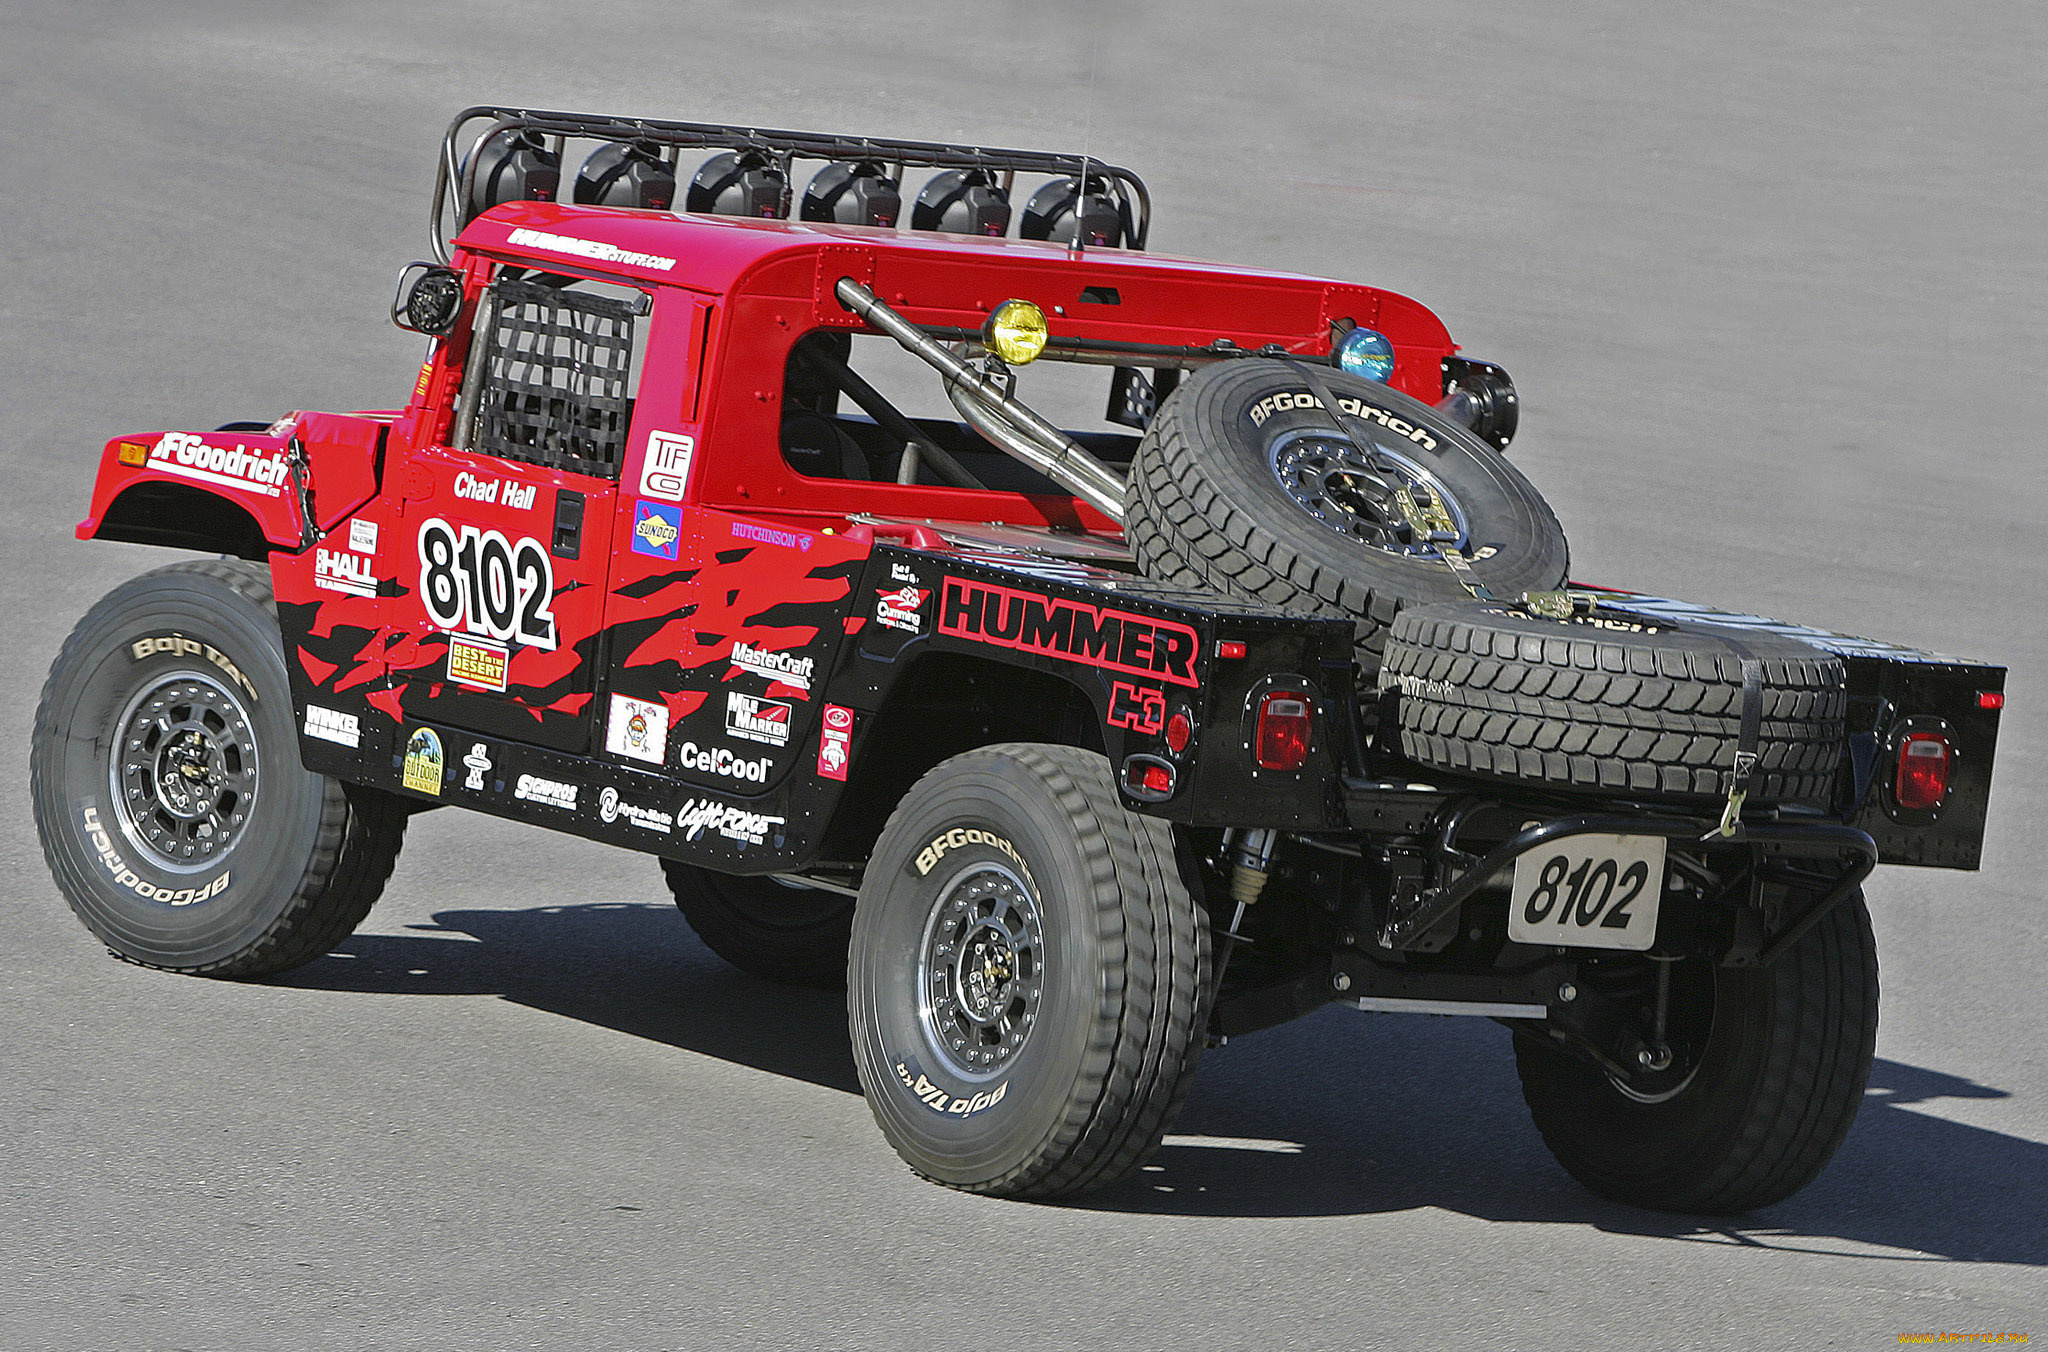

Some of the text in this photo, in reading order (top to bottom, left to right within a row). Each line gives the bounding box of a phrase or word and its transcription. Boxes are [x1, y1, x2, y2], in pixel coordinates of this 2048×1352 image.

[454, 471, 537, 510] Chad Hall
[638, 522, 675, 541] SUNOCO
[731, 522, 797, 548] HUTCHINSON
[325, 549, 378, 586] HALL
[417, 517, 557, 651] 8102
[877, 601, 921, 626] Cumming
[938, 575, 1199, 688] HUMMER
[452, 656, 504, 678] DESERT
[453, 643, 489, 662] BEST
[1107, 680, 1166, 735] H1
[405, 757, 440, 784] OUTDOOR
[680, 742, 769, 783] CelCool
[84, 807, 231, 906] BFGoodrich
[1524, 855, 1649, 929] 8102
